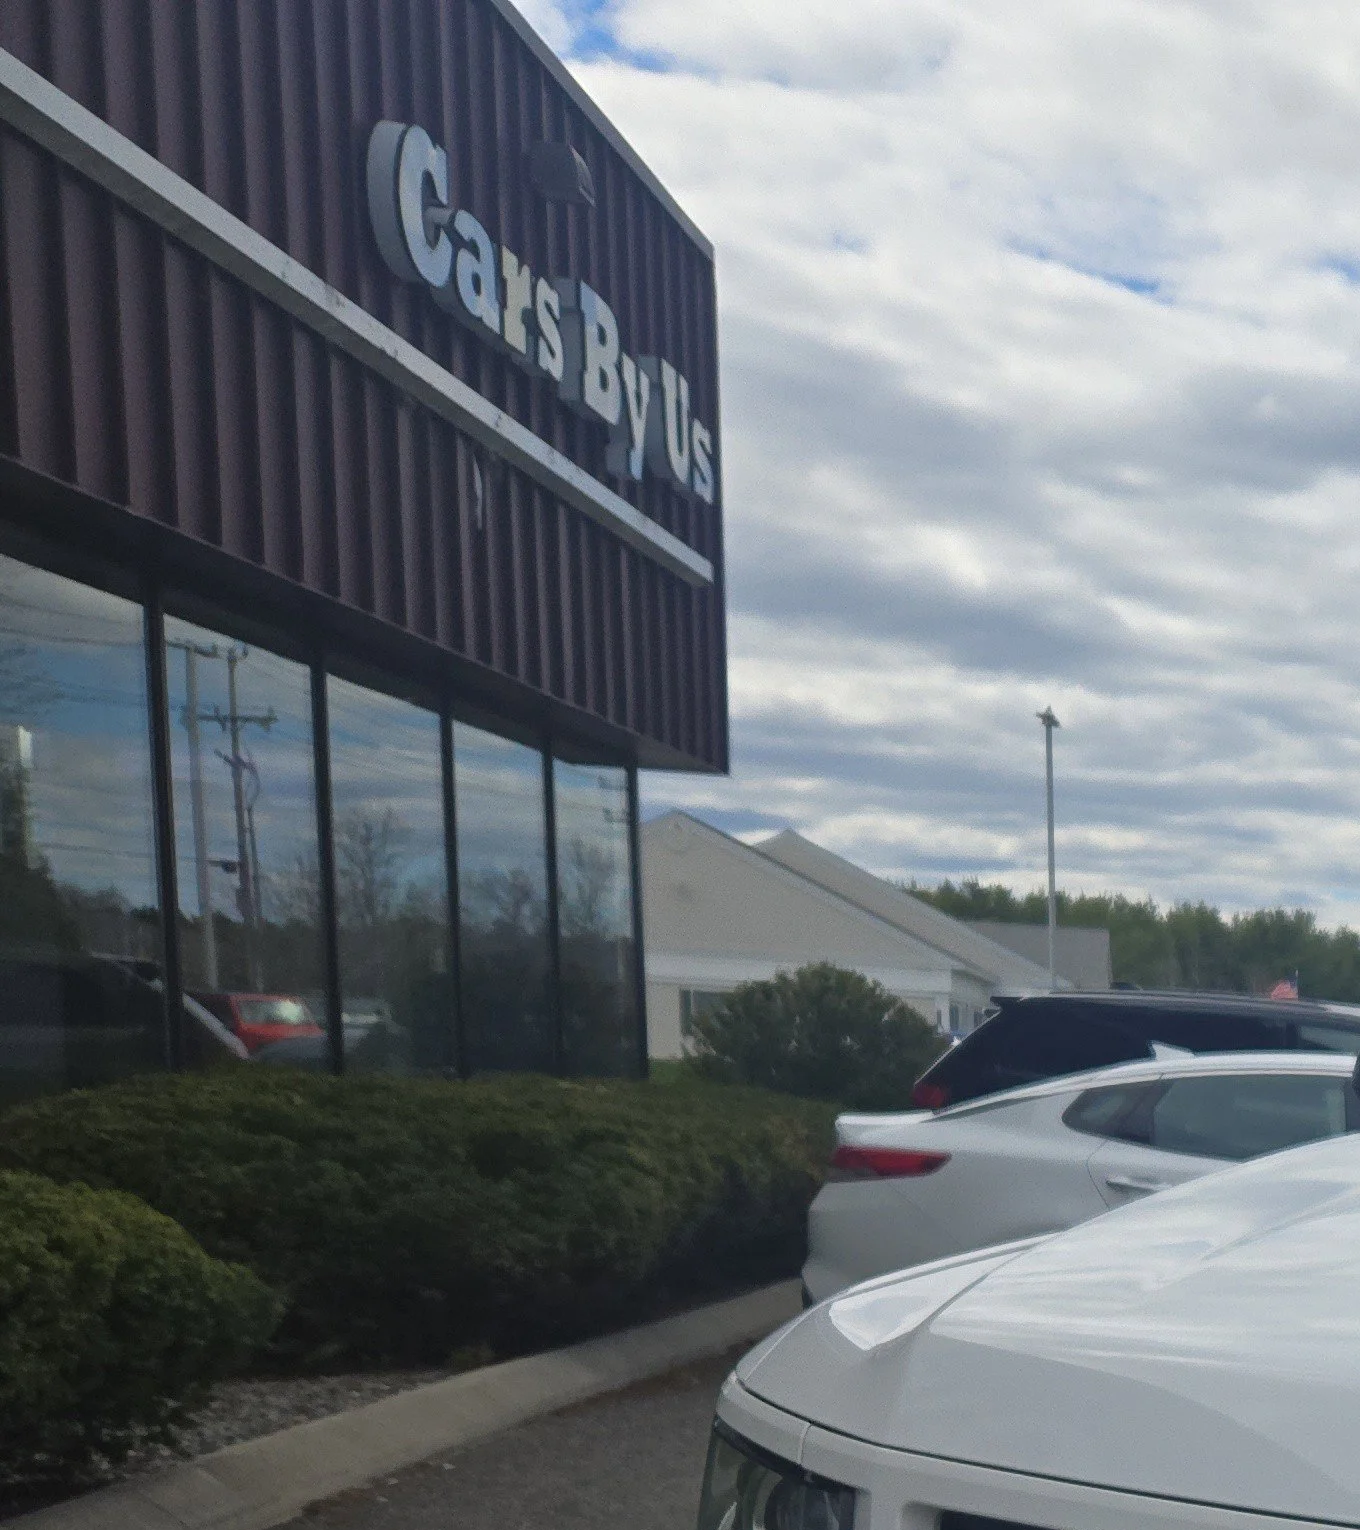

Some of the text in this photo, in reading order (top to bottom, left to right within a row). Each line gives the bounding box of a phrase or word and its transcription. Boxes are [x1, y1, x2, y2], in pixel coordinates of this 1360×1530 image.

[399, 124, 714, 504] Cars By Us
